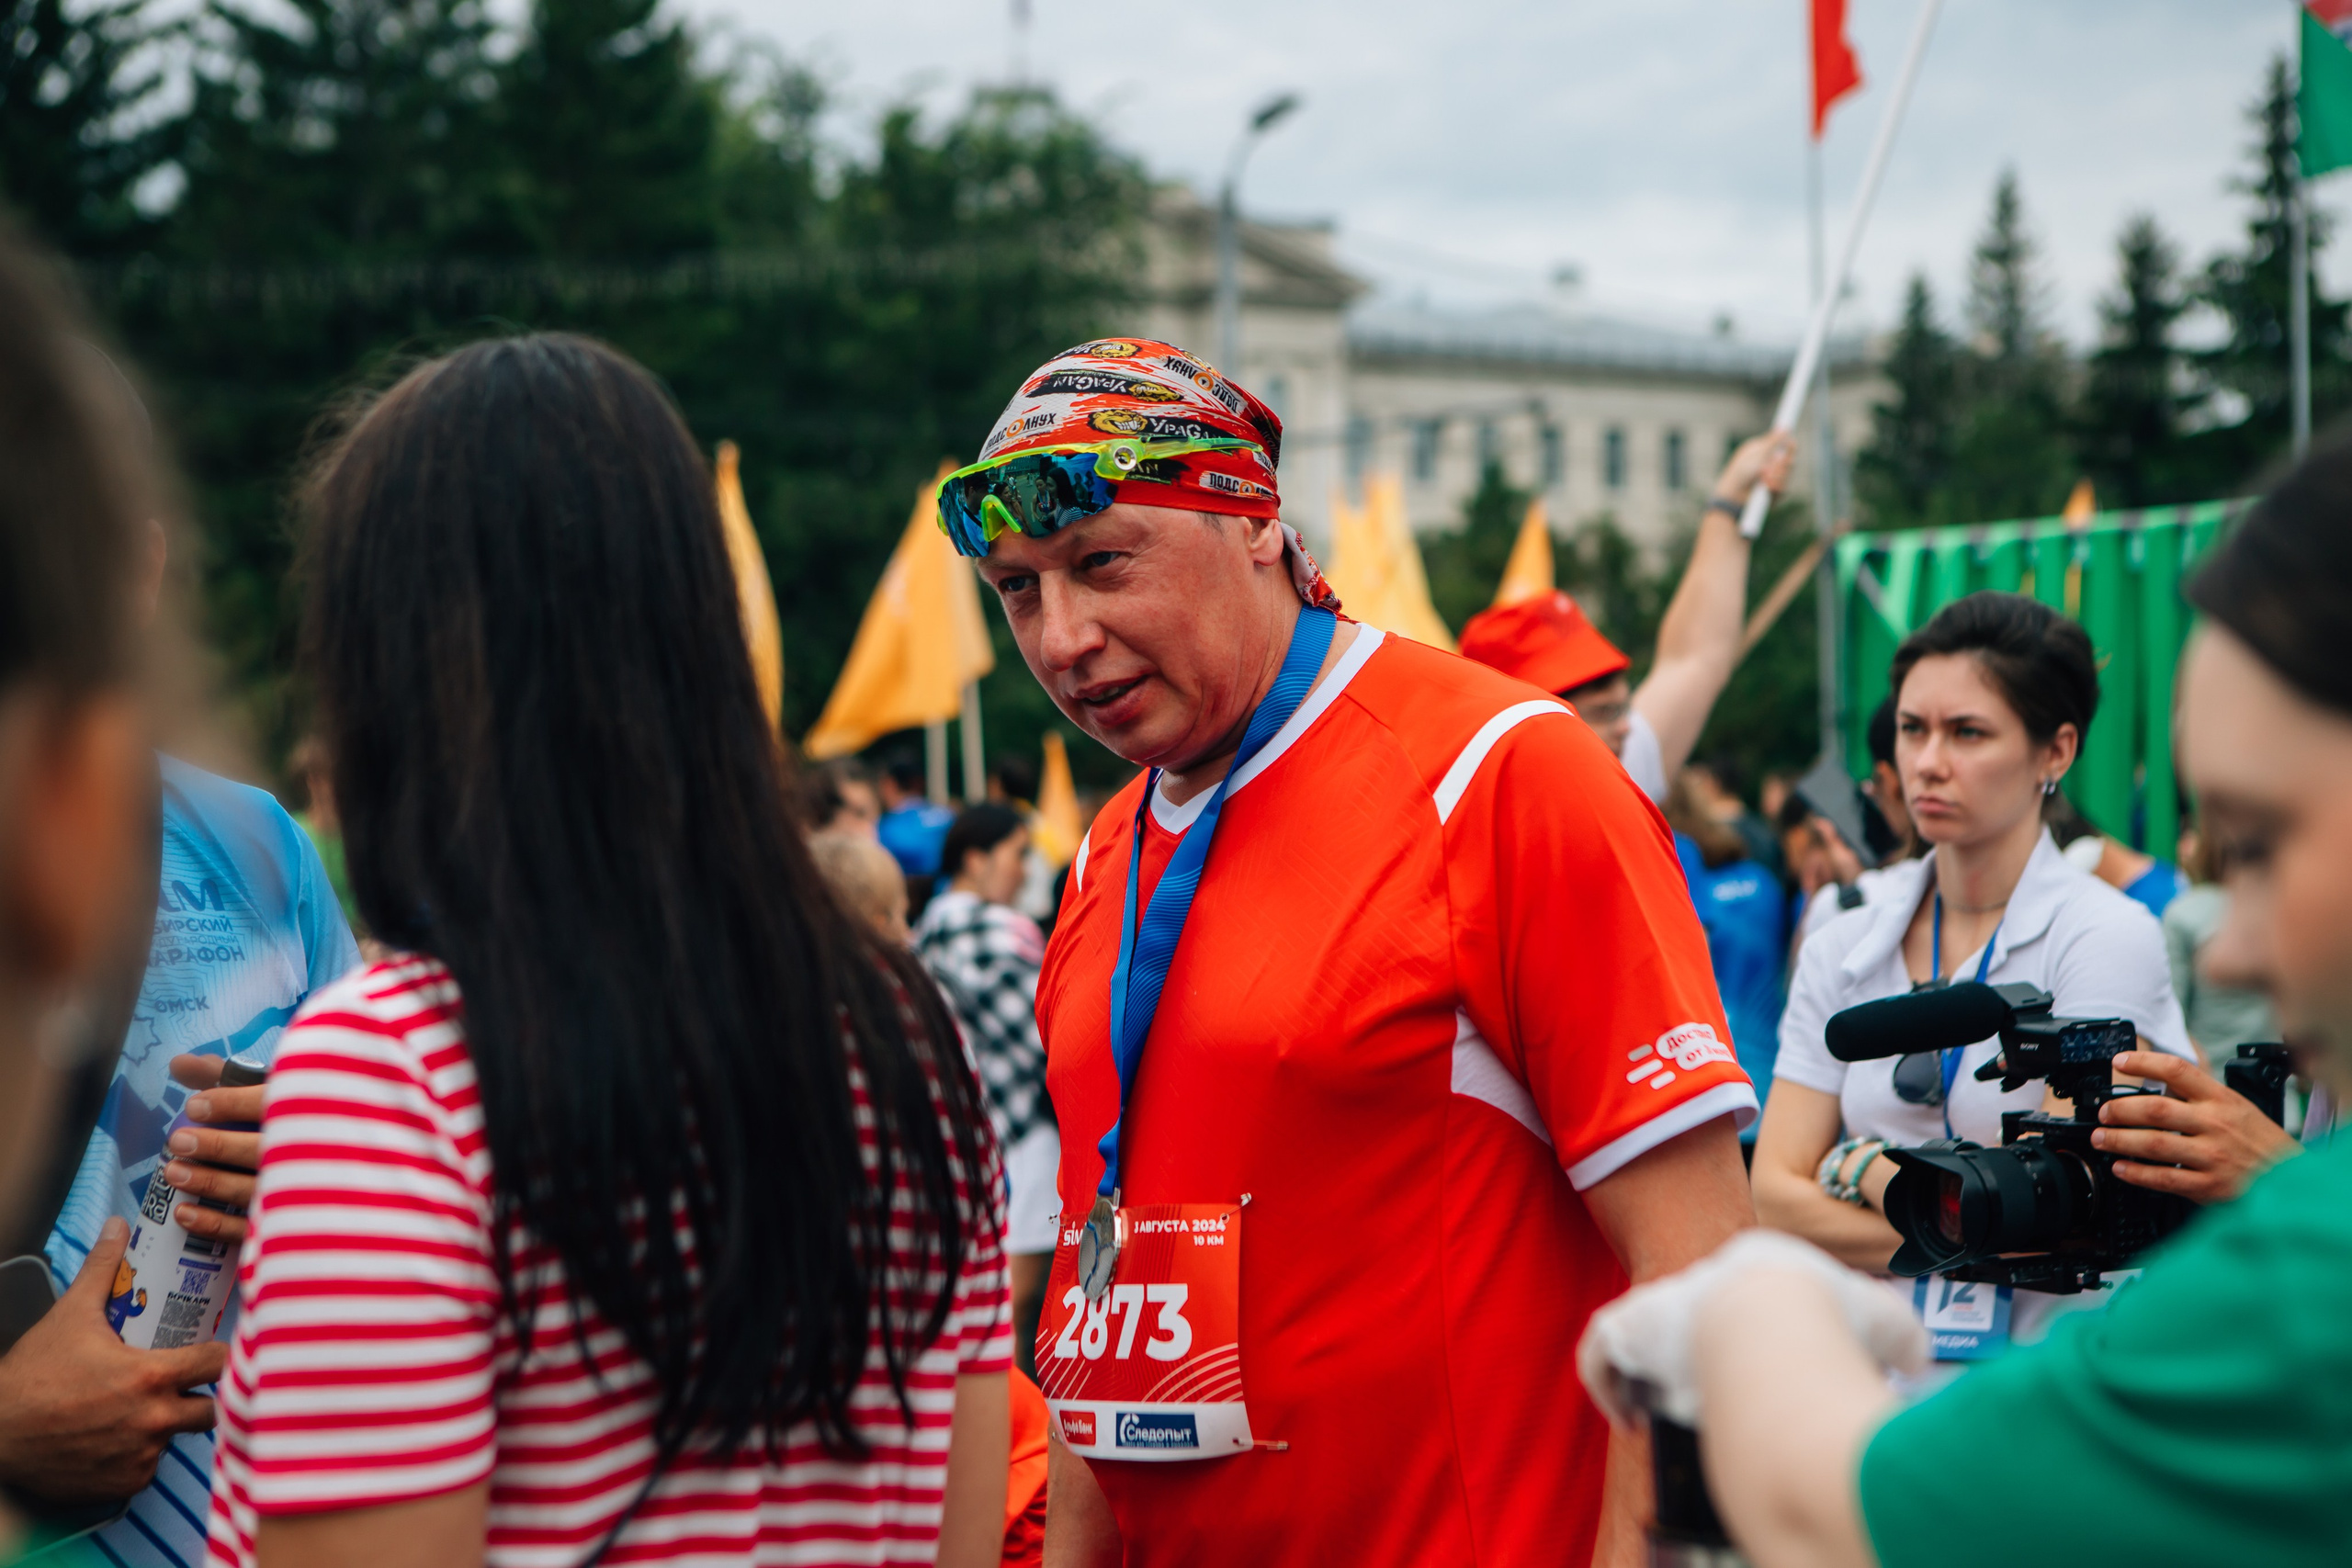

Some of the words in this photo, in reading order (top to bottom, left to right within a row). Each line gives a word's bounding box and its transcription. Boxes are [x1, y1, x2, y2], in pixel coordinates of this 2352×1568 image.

[154, 996, 209, 1013] ОМСК
[1139, 1219, 1189, 1233] АВГУСТА
[1192, 1219, 1227, 1233] 2024
[1193, 1235, 1204, 1246] 10
[1055, 1283, 1193, 1361] 2873
